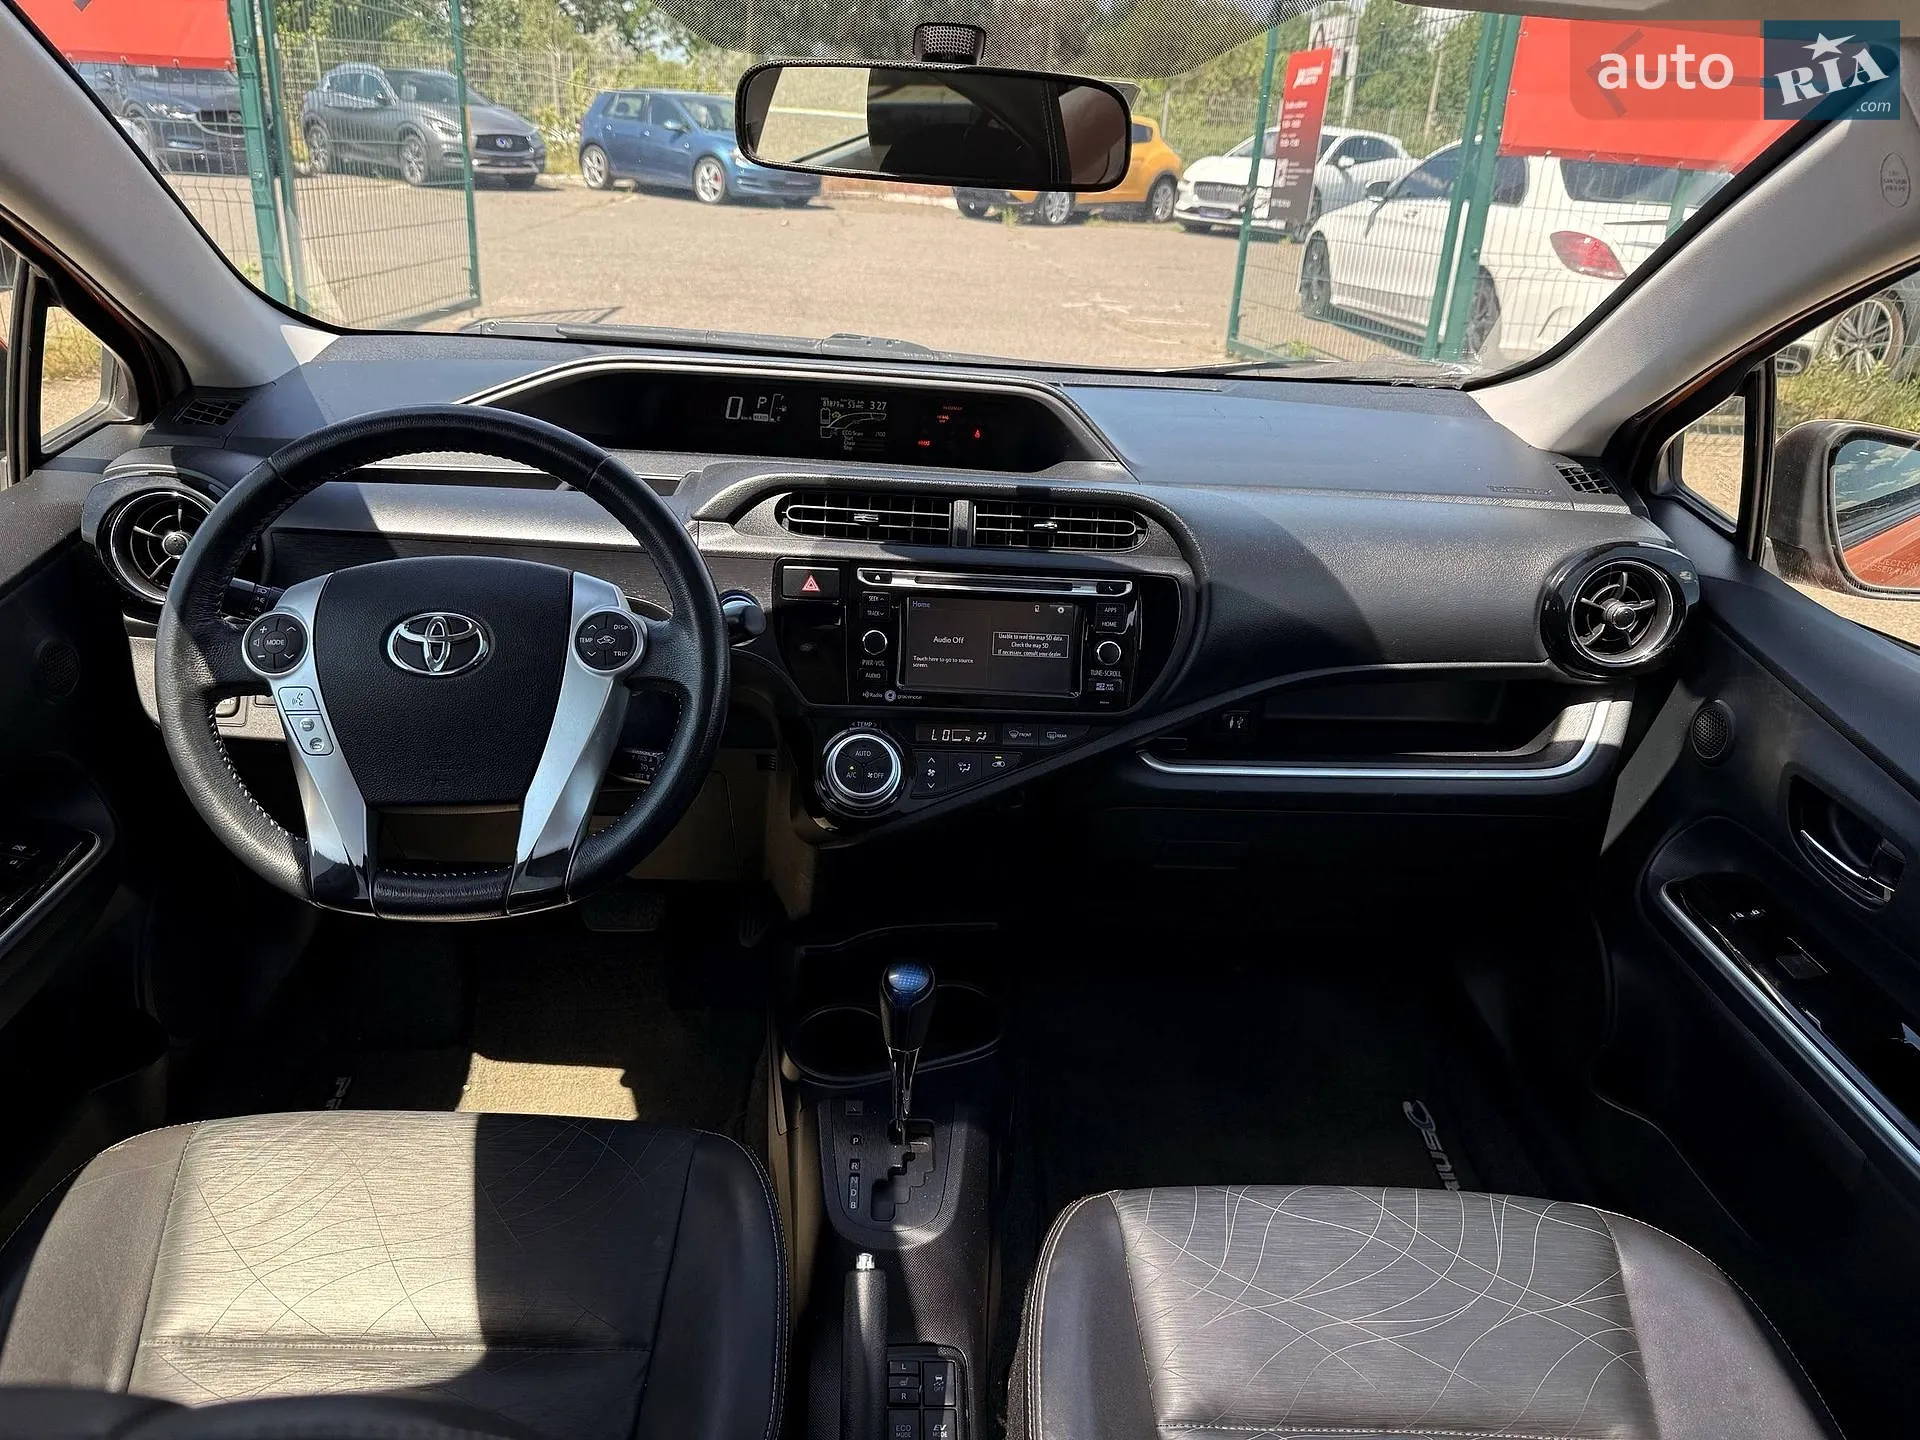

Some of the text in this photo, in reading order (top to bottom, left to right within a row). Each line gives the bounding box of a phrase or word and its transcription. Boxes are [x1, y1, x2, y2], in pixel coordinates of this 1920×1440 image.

[757, 396, 767, 409] P
[952, 636, 965, 644] Off
[931, 729, 950, 742] LO
[846, 771, 857, 779] A/C
[896, 1424, 912, 1432] ECO
